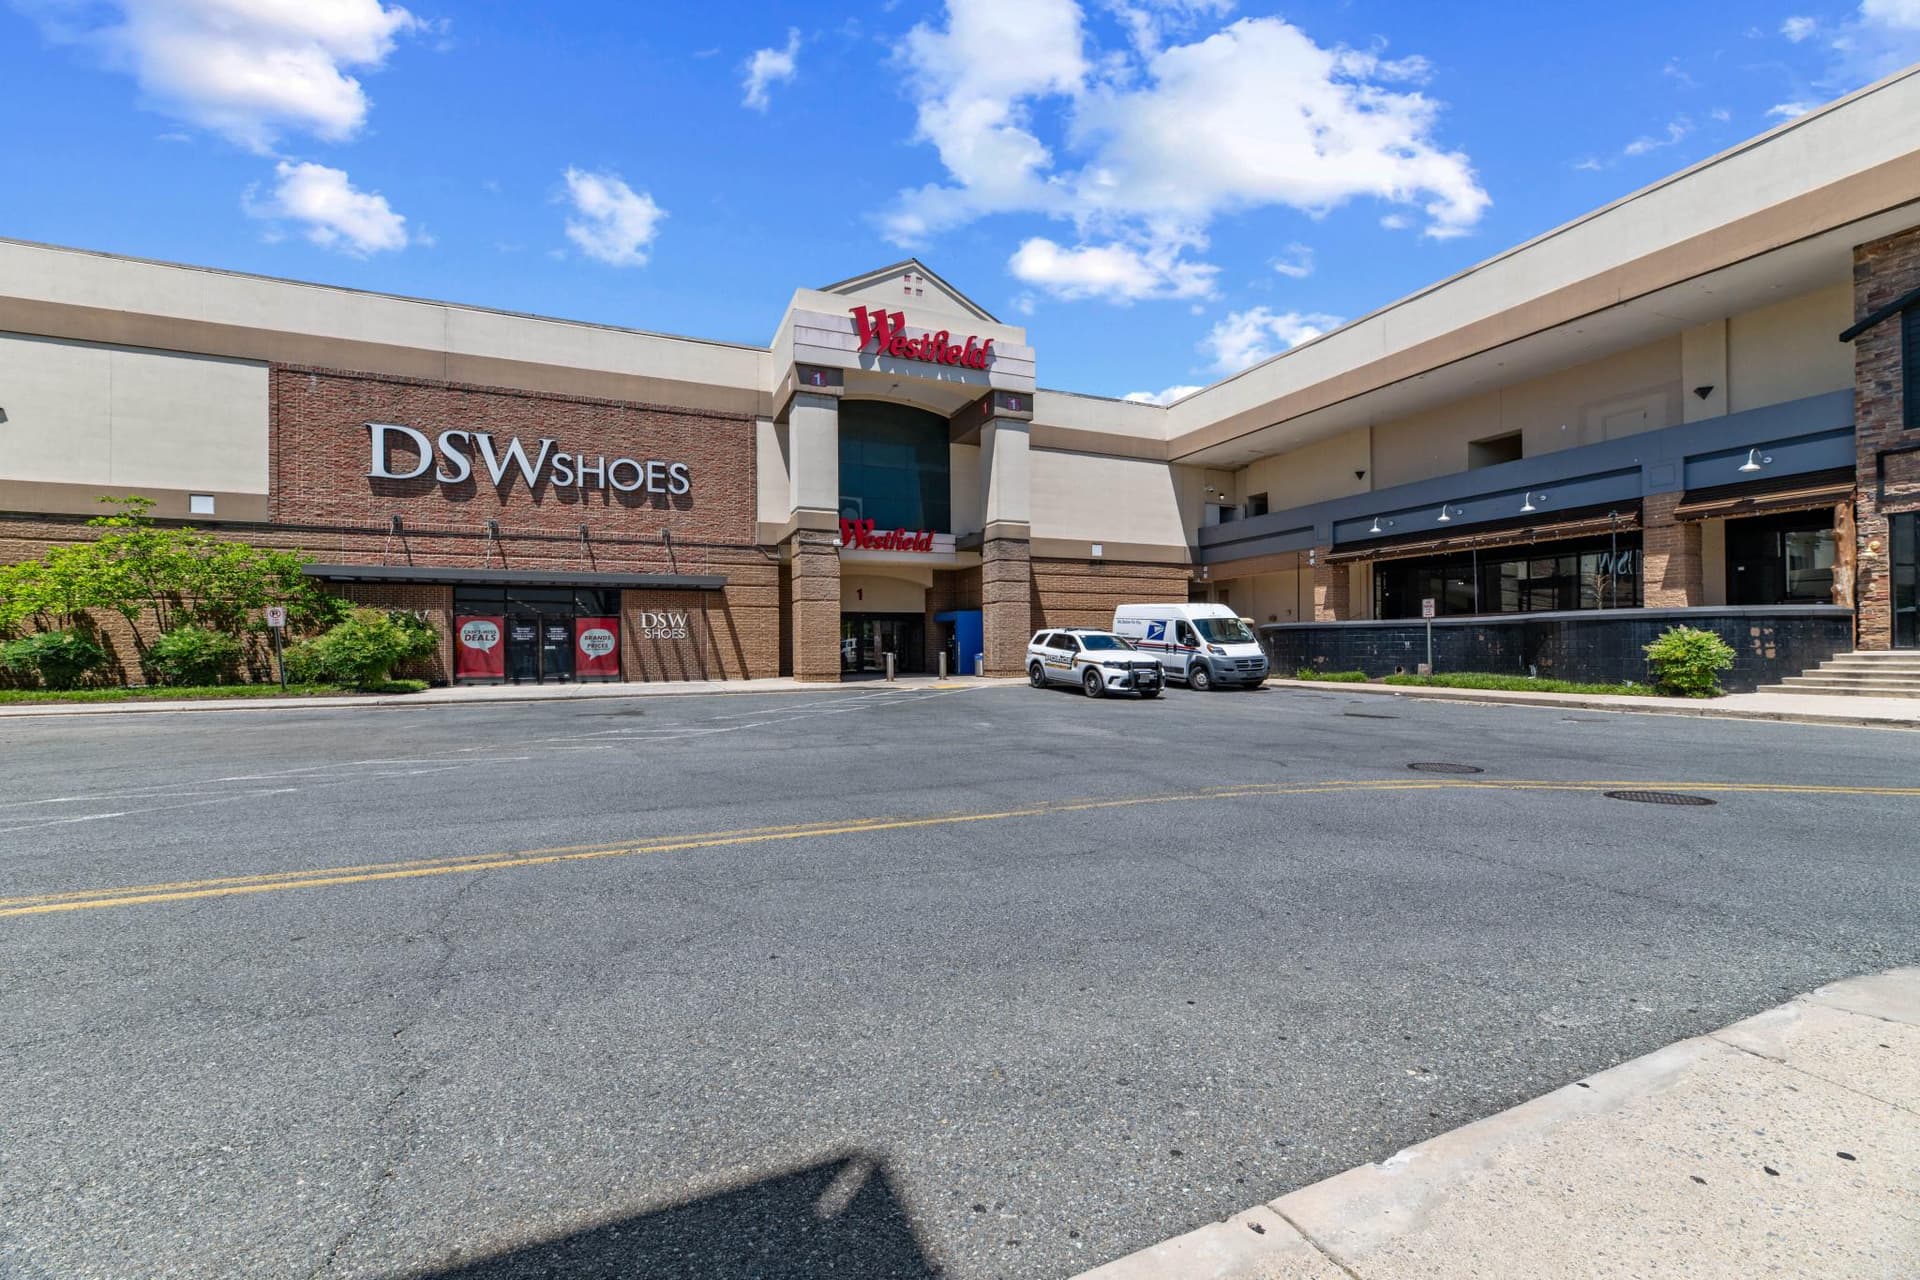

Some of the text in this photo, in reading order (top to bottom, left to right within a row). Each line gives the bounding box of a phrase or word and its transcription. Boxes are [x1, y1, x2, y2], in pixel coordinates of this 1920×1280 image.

[849, 305, 994, 369] Westfield
[364, 422, 690, 495] DSW SHOES
[839, 517, 935, 552] Westfield
[856, 588, 863, 601] 1
[641, 612, 688, 629] DSW
[644, 628, 686, 639] SHOES
